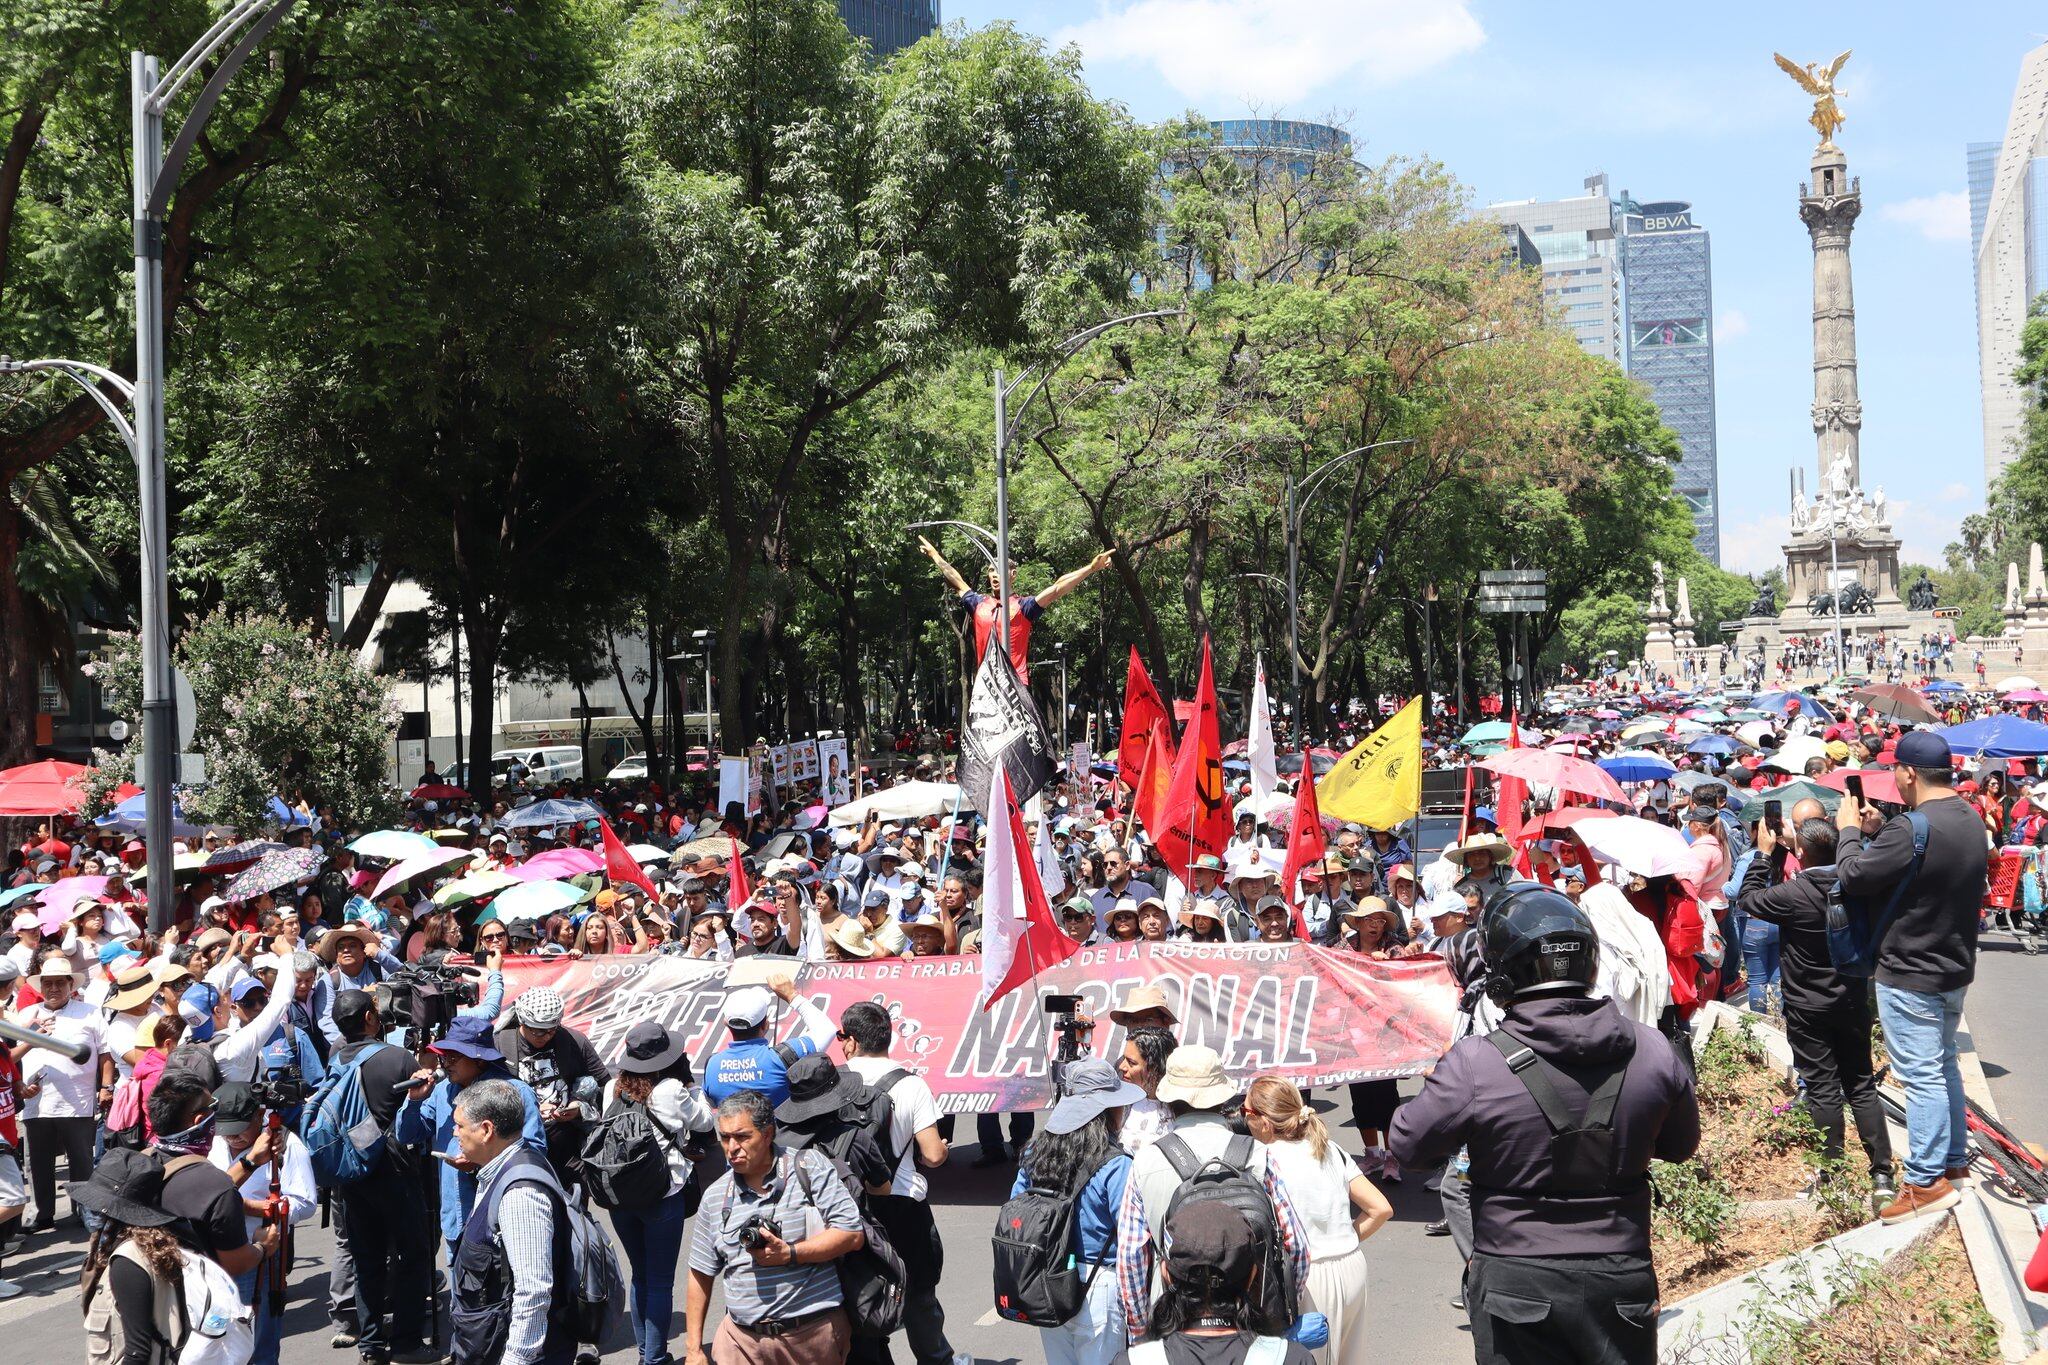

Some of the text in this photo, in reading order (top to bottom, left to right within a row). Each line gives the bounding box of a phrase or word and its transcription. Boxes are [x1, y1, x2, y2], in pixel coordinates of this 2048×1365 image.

[1645, 214, 1689, 230] BBVA
[1007, 687, 1019, 705] 11
[875, 966, 902, 979] DE
[1080, 949, 1107, 966] DE
[1115, 945, 1141, 962] LA
[720, 1058, 757, 1070] PRENSA
[718, 1070, 763, 1082] SECCIÓN 7
